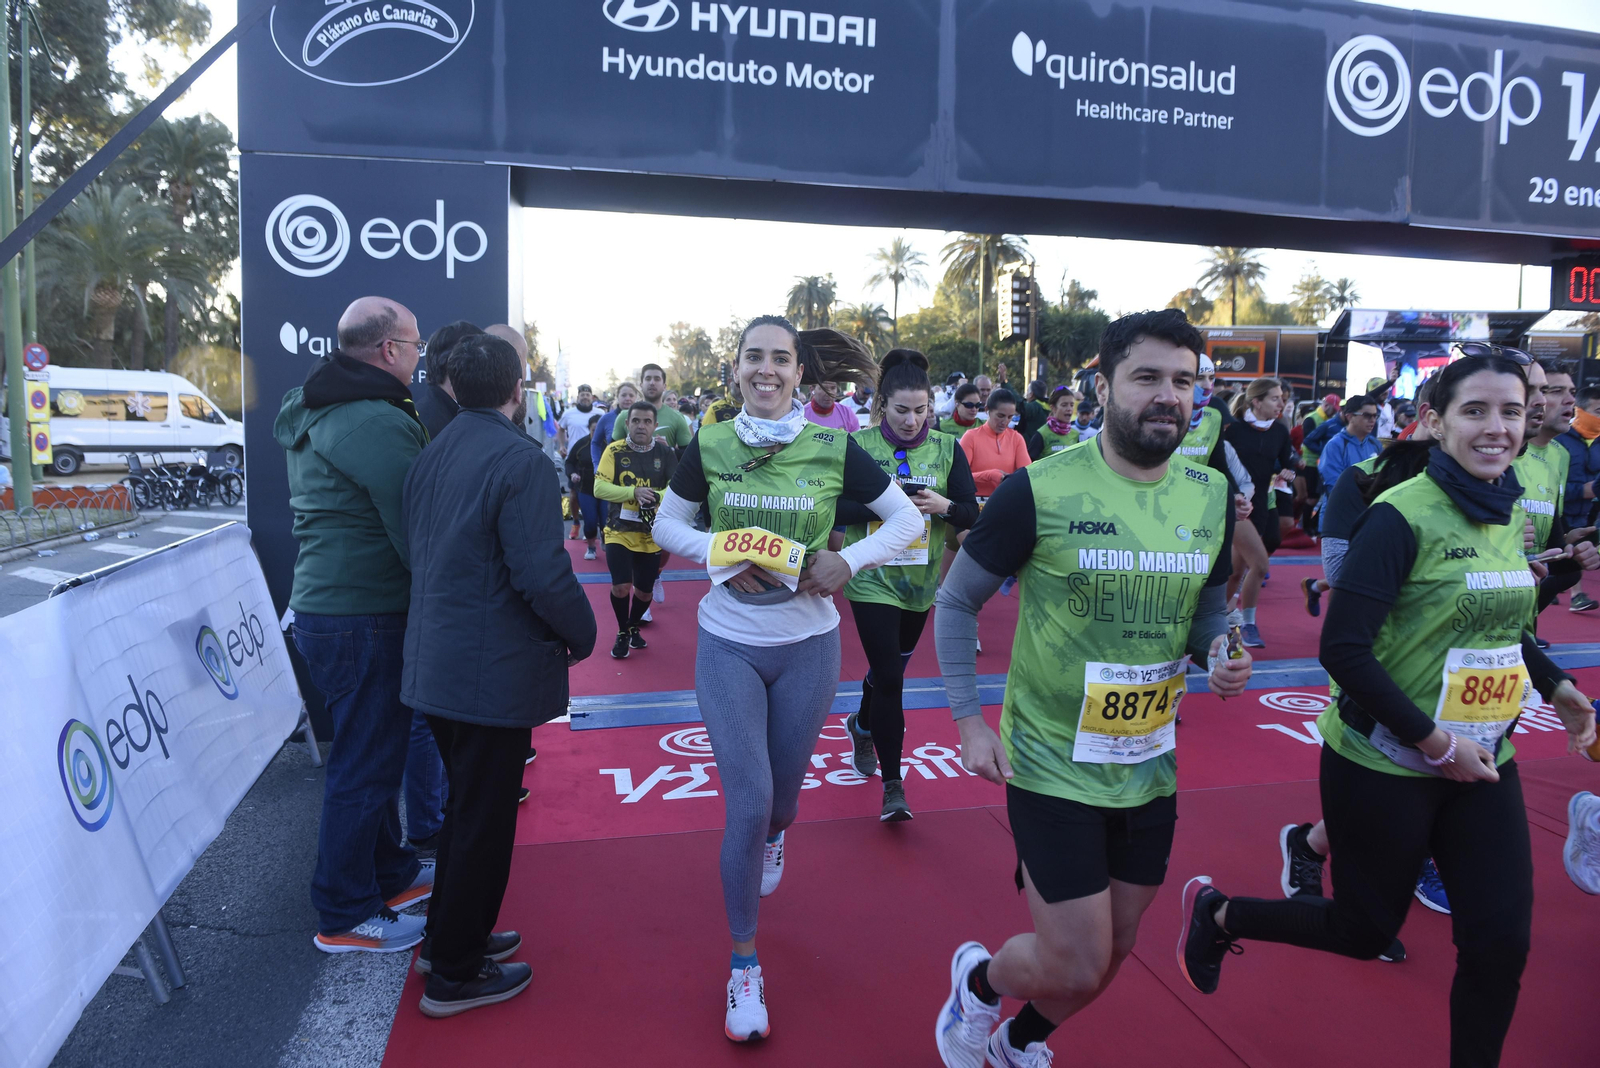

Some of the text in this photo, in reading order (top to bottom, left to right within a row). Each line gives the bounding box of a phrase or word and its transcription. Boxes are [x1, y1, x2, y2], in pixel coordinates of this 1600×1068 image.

[316, 4, 438, 48] Plátano de Canarias
[691, 1, 877, 47] HYUNDAI
[602, 46, 874, 94] Hyundauto Motor
[1045, 50, 1236, 95] quirónsalud
[1076, 98, 1234, 130] Healthcare Partner
[1418, 48, 1600, 163] edp 1/
[1528, 176, 1559, 204] 29
[359, 199, 488, 279] edp
[813, 432, 835, 443] 2023
[874, 460, 890, 468] OKA
[1184, 467, 1209, 483] 2023
[808, 478, 825, 488] edp
[723, 491, 815, 511] MEDIO MARATÓN
[1068, 521, 1119, 535] HOKA
[1192, 525, 1212, 541] edp
[723, 532, 784, 558] 8846
[1445, 547, 1479, 560] HOKA
[1078, 548, 1210, 575] MEDIO MARATÓN
[1465, 571, 1504, 590] MEDIO
[225, 601, 265, 667] edp
[1122, 630, 1167, 640] 28ª Edición
[1115, 669, 1138, 681] edp
[1461, 673, 1519, 705] 8847
[1101, 686, 1169, 721] 8874
[106, 674, 170, 771] edp
[1081, 725, 1107, 733] MIGUEL
